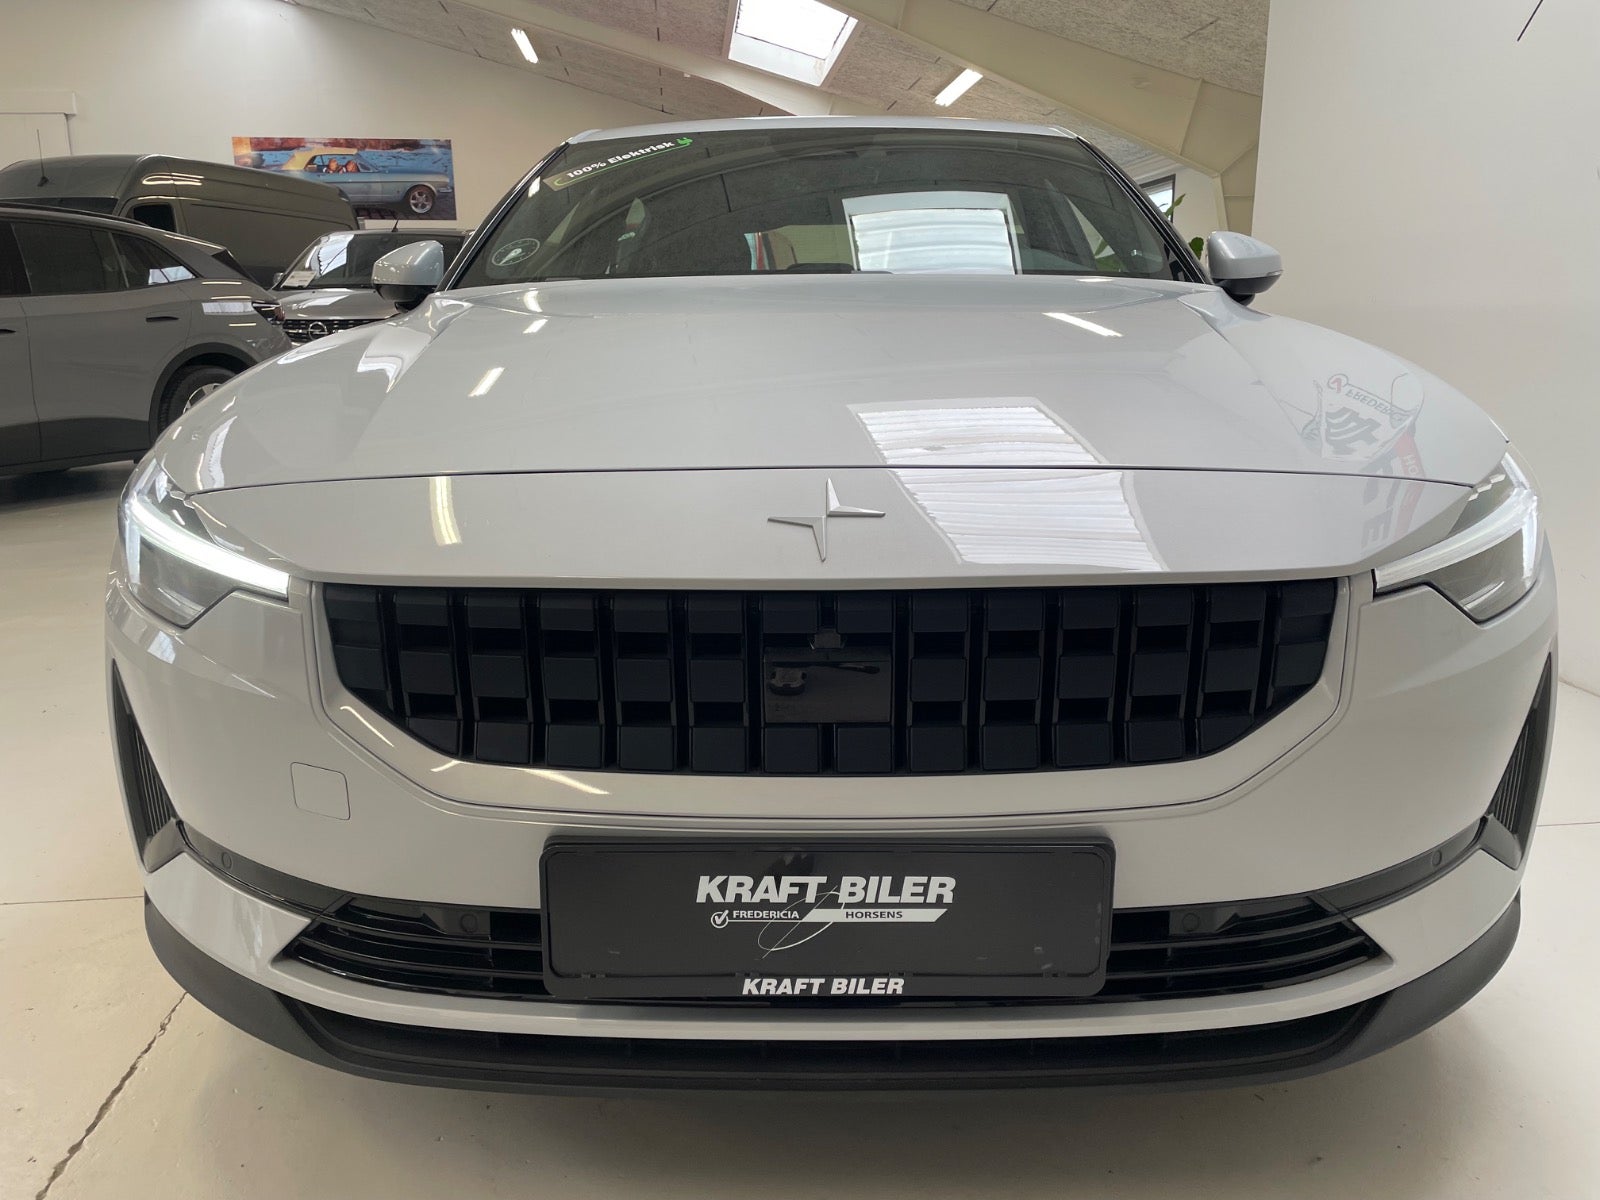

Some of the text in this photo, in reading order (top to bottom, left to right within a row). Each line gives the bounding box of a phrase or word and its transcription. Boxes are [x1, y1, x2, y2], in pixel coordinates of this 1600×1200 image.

[566, 141, 676, 179] 100% Elektrisk
[696, 875, 957, 904] KRAFT BILER
[732, 909, 904, 920] FREDERICIA HORSENS
[742, 977, 905, 996] KRAFT BILER
